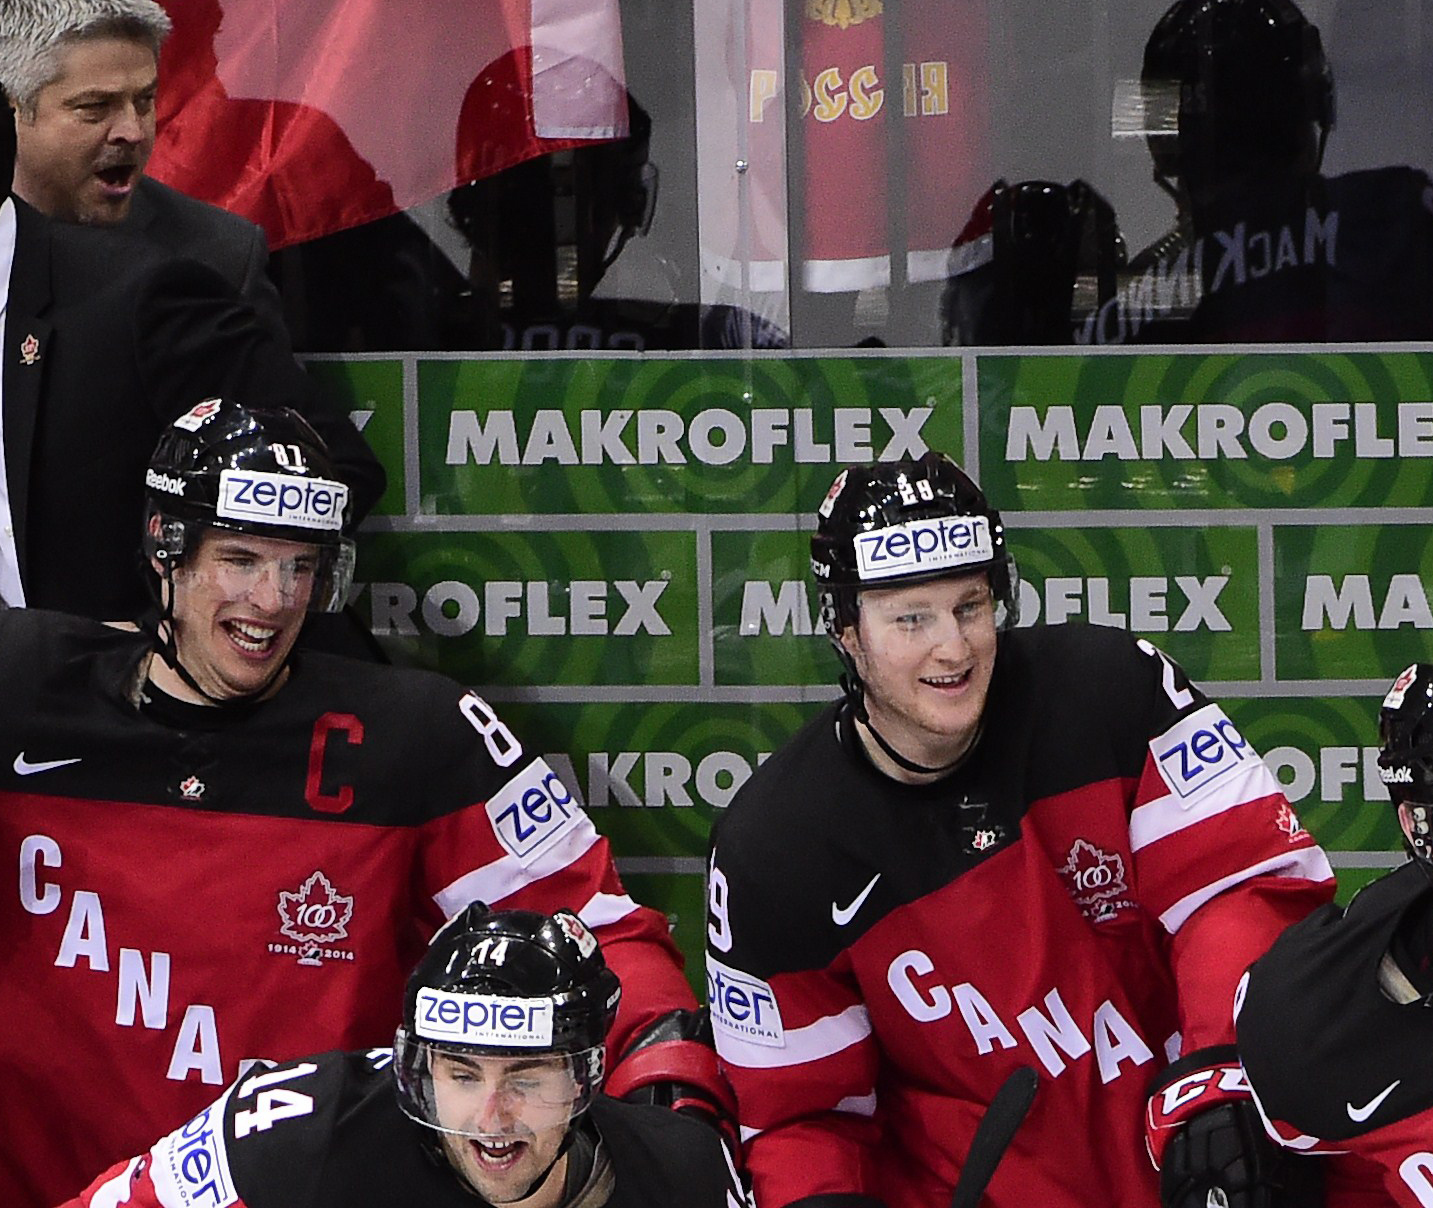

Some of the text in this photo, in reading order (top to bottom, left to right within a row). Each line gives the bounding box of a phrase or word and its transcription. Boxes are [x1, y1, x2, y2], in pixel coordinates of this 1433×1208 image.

[445, 405, 936, 468] MAKROFLEX
[272, 442, 307, 474] 87
[145, 467, 188, 497] Reebok
[226, 476, 345, 518] zepter
[859, 520, 985, 564] zepter
[303, 711, 365, 814] C
[1072, 864, 1113, 892] 100
[296, 903, 337, 932] 100
[18, 832, 278, 1086] CANA
[267, 943, 298, 955] 1914
[323, 948, 356, 962] 2014
[472, 936, 511, 967] 14
[421, 995, 547, 1035] zepter
[887, 949, 1182, 1085] CANA
[234, 1063, 319, 1139] 14
